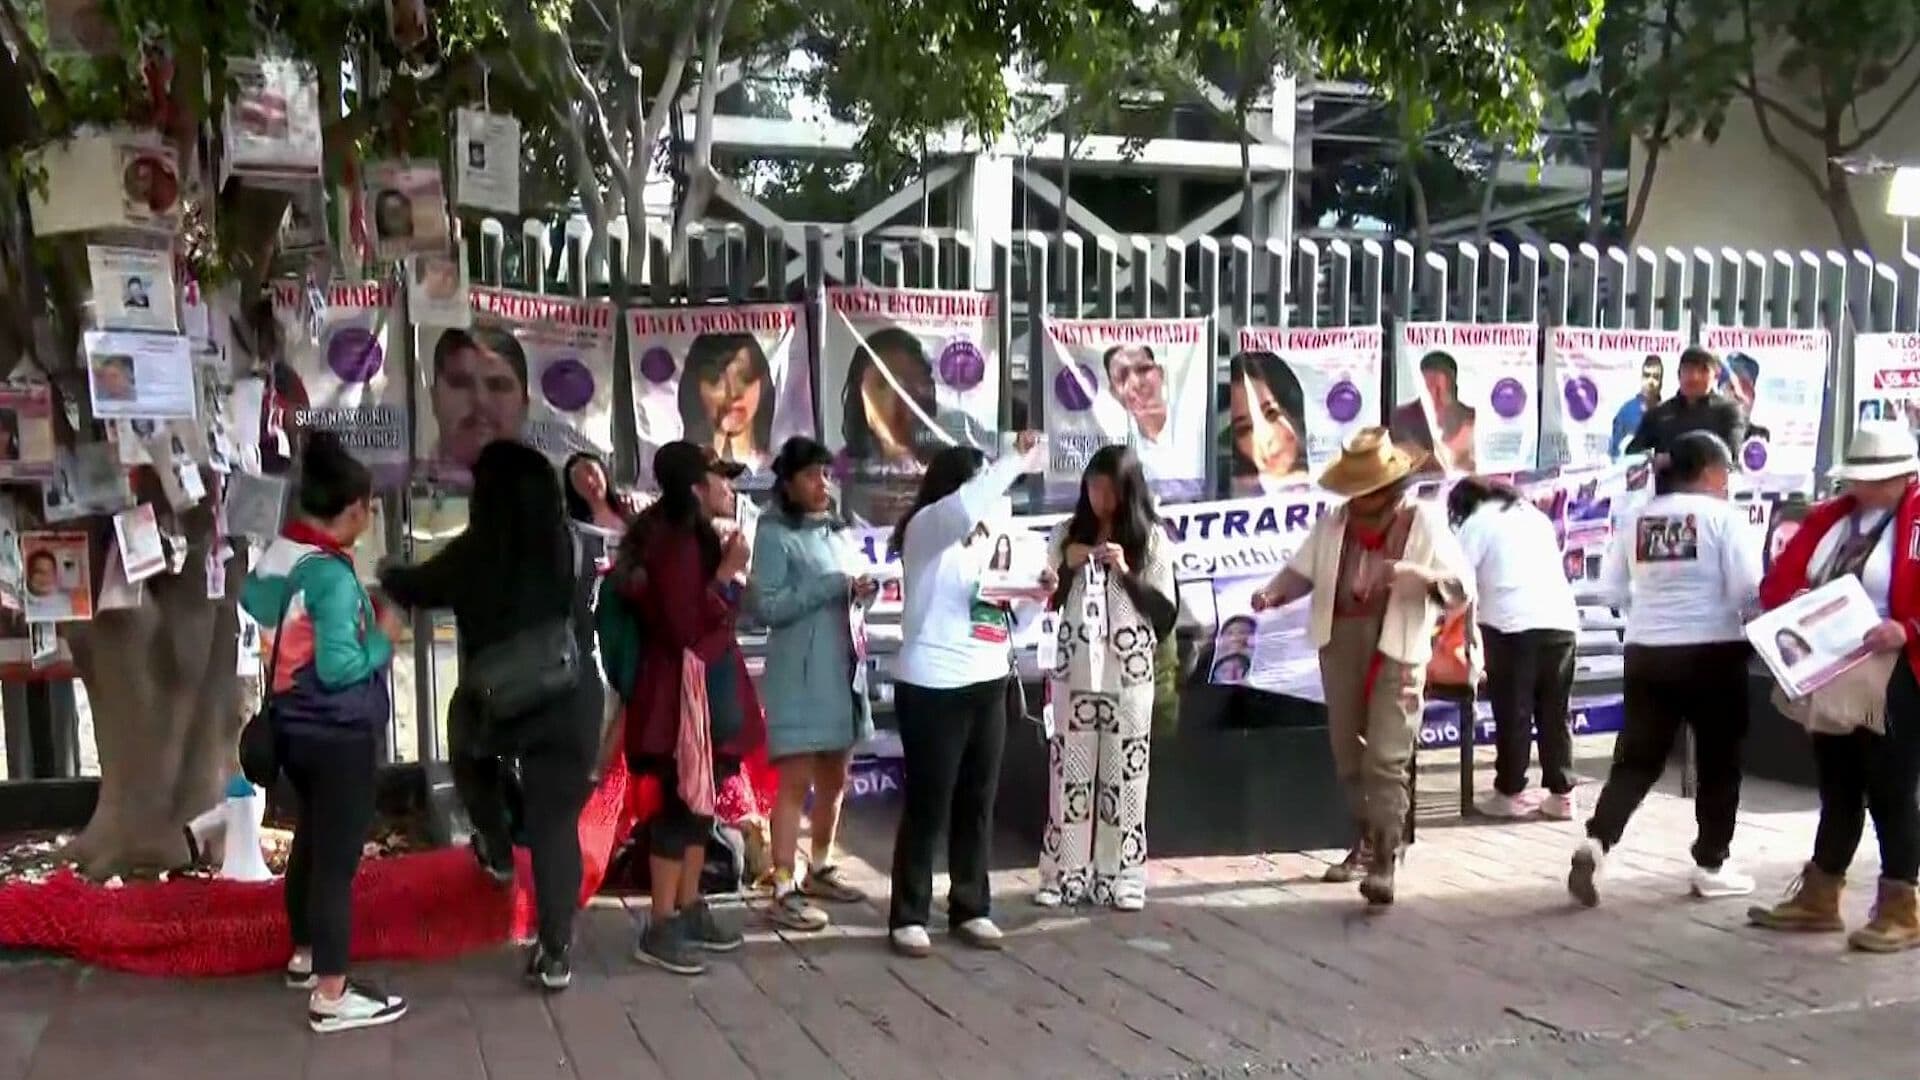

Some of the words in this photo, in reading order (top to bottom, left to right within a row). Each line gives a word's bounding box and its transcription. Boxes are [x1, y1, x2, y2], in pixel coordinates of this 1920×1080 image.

[834, 291, 881, 313] HASTA
[887, 294, 994, 318] ENCONTRARTE
[634, 313, 686, 336] HASTA
[1099, 324, 1201, 344] ENCONTRARTE
[1239, 330, 1283, 351] HASTA
[1406, 326, 1447, 346] HASTA
